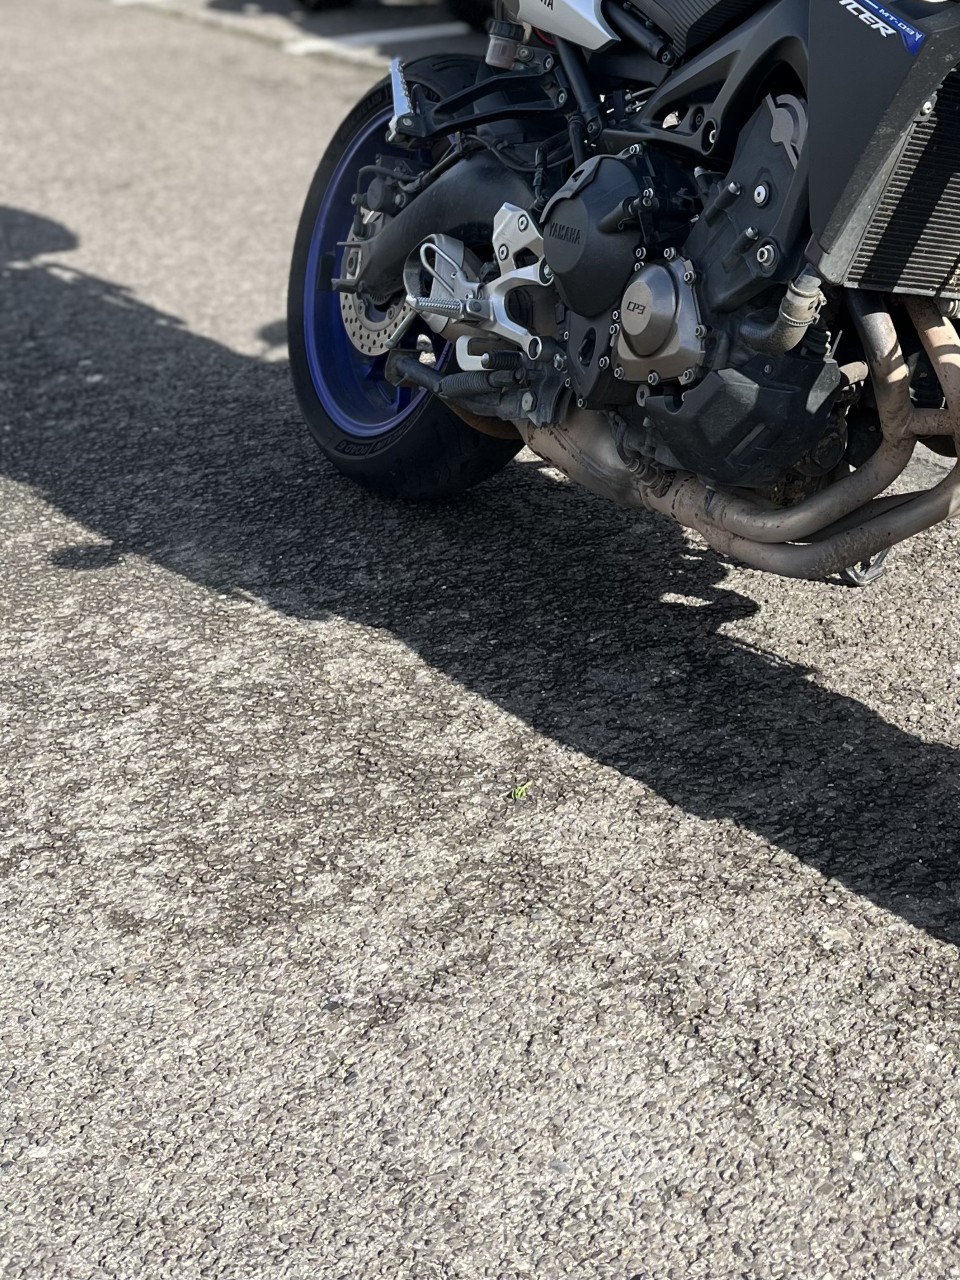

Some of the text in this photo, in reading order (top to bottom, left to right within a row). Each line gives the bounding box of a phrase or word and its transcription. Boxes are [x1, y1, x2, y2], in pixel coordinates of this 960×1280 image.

[878, 8, 915, 36] MT-09
[549, 222, 581, 245] YAMAHA
[626, 301, 646, 315] CP3
